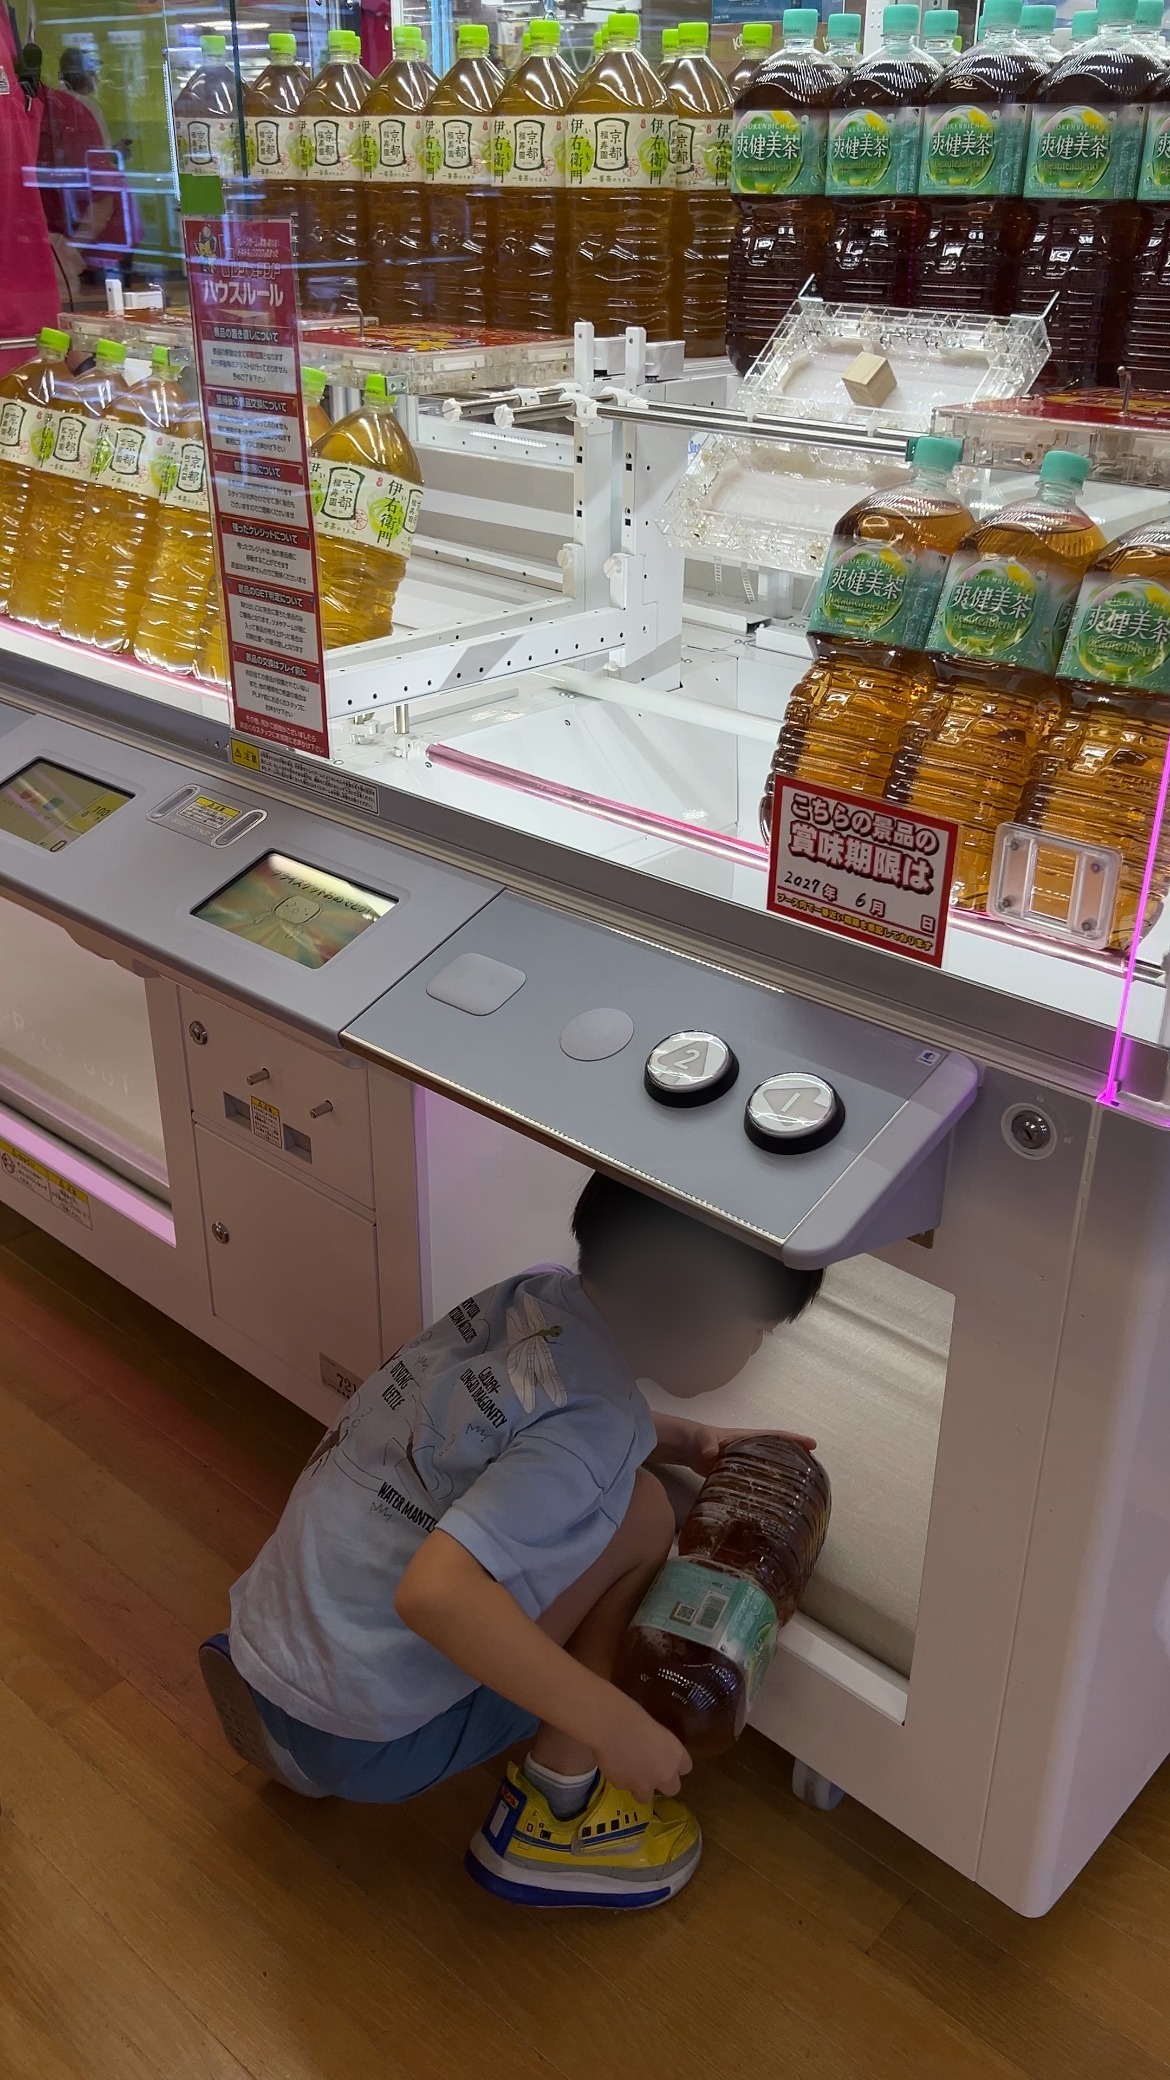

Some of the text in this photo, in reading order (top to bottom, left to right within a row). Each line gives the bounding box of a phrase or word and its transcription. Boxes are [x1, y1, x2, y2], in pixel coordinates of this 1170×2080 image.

[265, 130, 276, 156] 京都
[324, 130, 335, 156] 京都
[362, 120, 373, 178] 伊右衛門
[390, 130, 400, 158] 京都
[425, 119, 436, 181] 伊右衛門
[454, 130, 467, 159] 京都
[493, 120, 506, 184] 伊右衛門
[526, 130, 539, 161] 京都
[570, 118, 585, 185] 伊右衛門
[609, 129, 623, 161] 京都
[650, 118, 665, 185] 伊右衛門
[736, 131, 801, 161] 爽健美茶
[833, 131, 889, 160] 爽健美茶
[930, 130, 993, 158] 爽健美茶
[1039, 131, 1108, 160] 爽健美茶
[203, 279, 284, 307] ハウスルール
[64, 427, 79, 454] 京都
[188, 455, 202, 484] 京都
[337, 479, 356, 511] 京都
[376, 479, 405, 548] 伊右衛門
[231, 522, 298, 544] 残ったクレジットについて
[829, 564, 904, 600] 爽健美茶
[949, 581, 1033, 620] 爽健美茶
[1083, 604, 1170, 645] 爽健美茶
[245, 652, 307, 677] 景品の交換はプレイ前に
[790, 792, 940, 856] こちらの景品の
[788, 819, 935, 896] 賞味期限は
[783, 870, 936, 933] 2027 年 6 月 日
[674, 1048, 700, 1070] 2
[780, 1091, 801, 1113] 1
[389, 1360, 414, 1390] DIVING
[471, 1385, 508, 1429] DRAGONFLY
[377, 1481, 406, 1512] WATER
